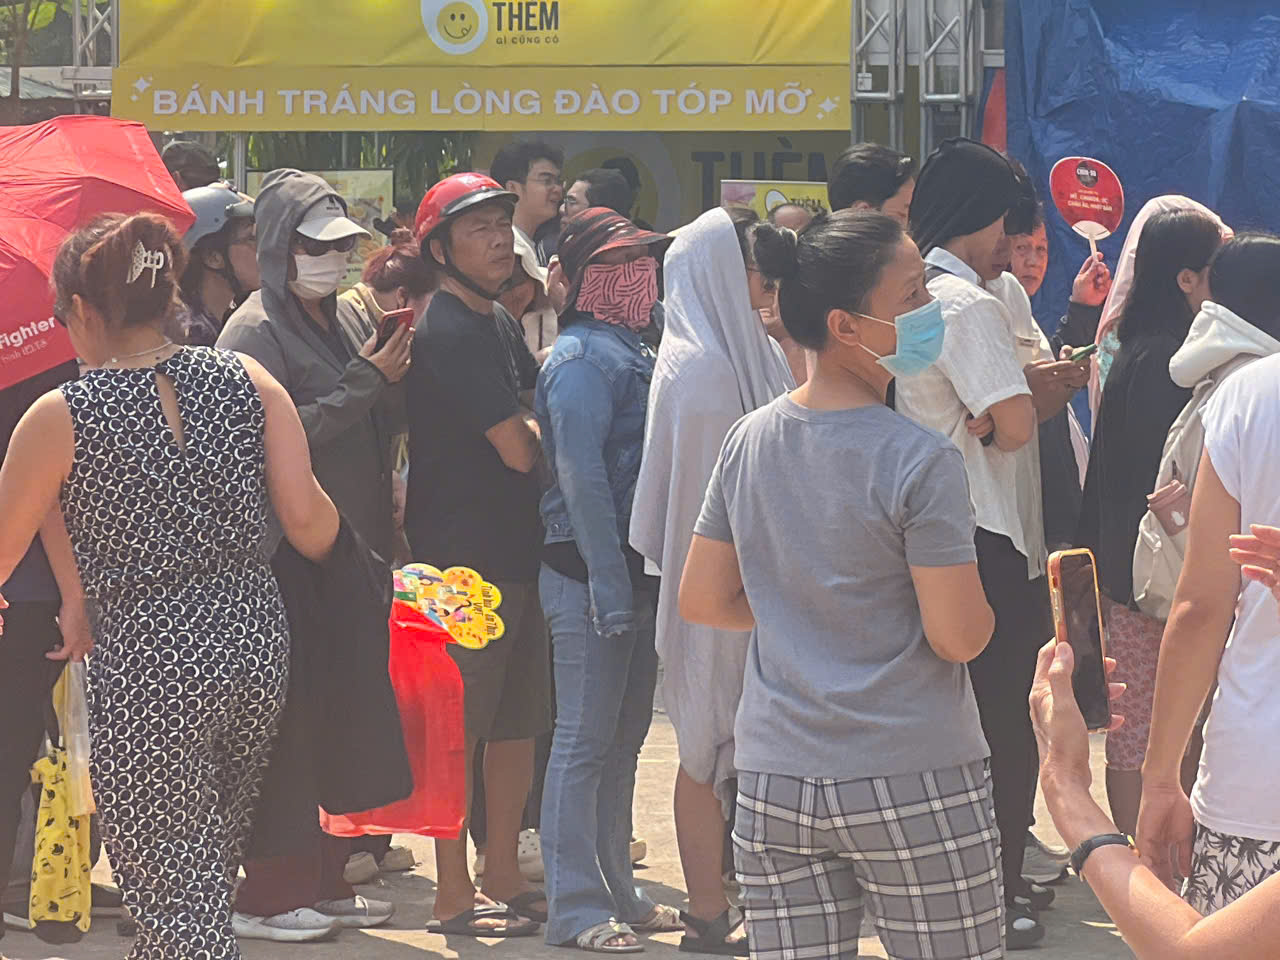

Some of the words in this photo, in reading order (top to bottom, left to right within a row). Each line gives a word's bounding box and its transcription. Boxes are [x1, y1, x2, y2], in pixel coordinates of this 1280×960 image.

[511, 34, 541, 45] CŨNG
[545, 34, 559, 44] CÓ
[153, 82, 265, 115] BÁNH
[278, 82, 416, 115] TRÁNG
[430, 81, 542, 115] LÒNG
[553, 82, 641, 116] ĐÀO
[652, 82, 733, 115] TÓP
[744, 82, 813, 115] MỠ
